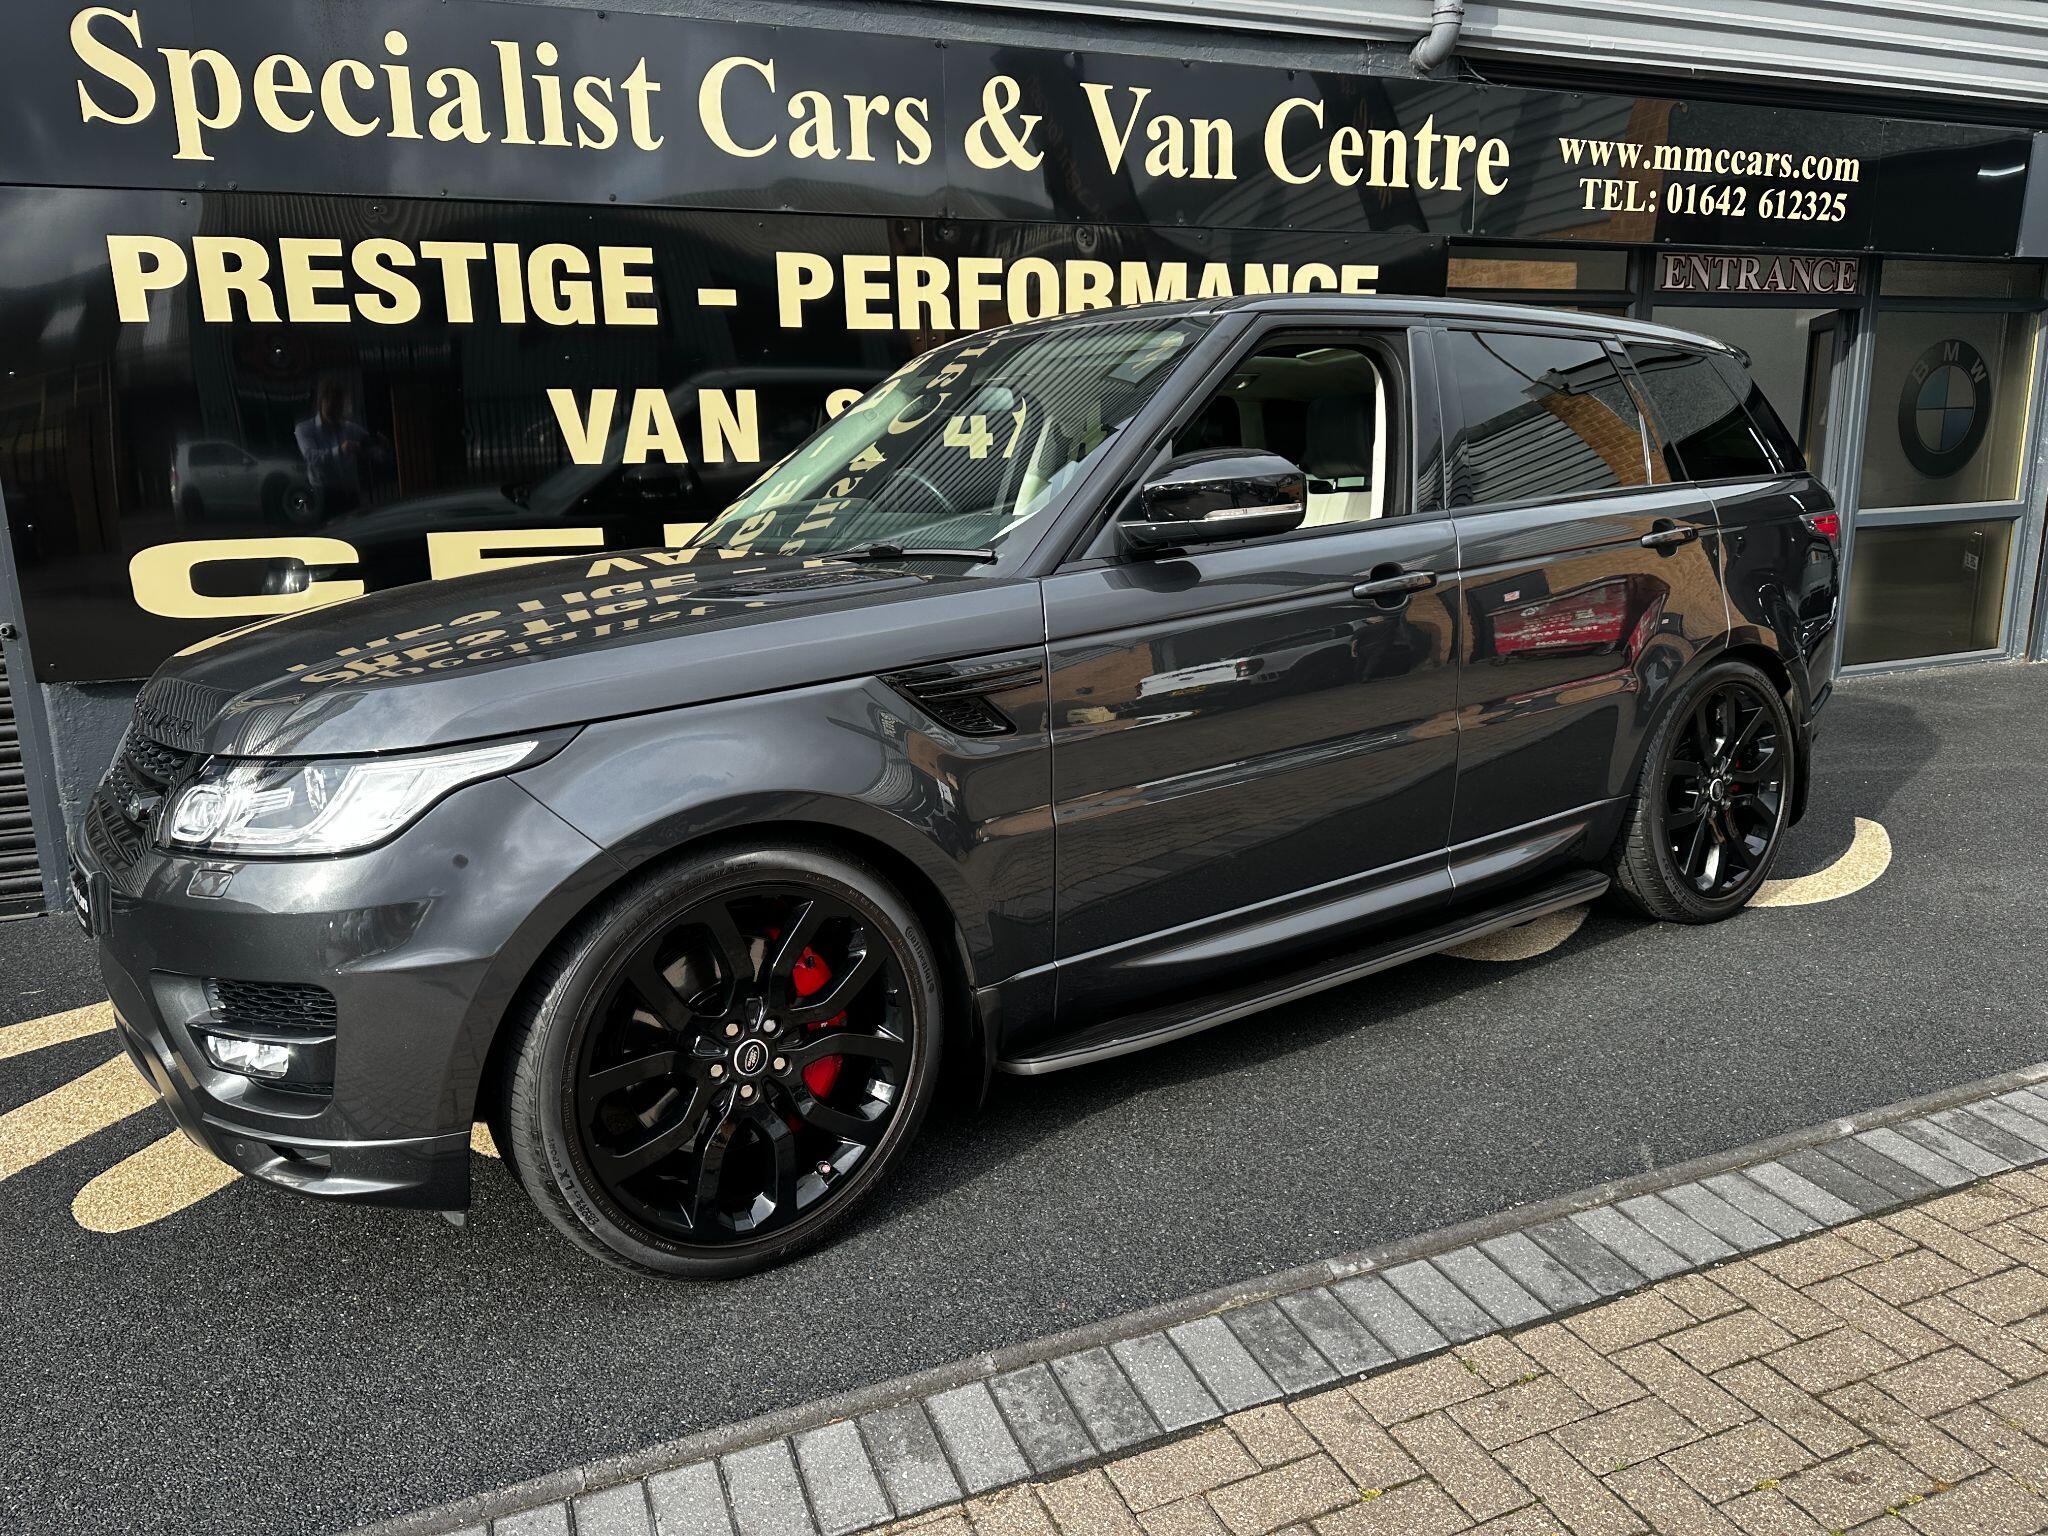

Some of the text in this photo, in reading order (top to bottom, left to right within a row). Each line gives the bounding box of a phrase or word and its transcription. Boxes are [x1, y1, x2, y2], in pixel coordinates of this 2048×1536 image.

[70, 8, 664, 161] Specialist
[697, 57, 934, 166] Cars
[964, 75, 1044, 172] &
[1079, 82, 1238, 180] Van
[1263, 98, 1511, 196] Centre
[1558, 137, 1860, 183] www.mmccars.com
[1579, 177, 1848, 223] TEL: 01642 612325
[107, 235, 660, 326] PRESTIGE
[1661, 254, 1857, 295] ENTRANCE
[1911, 341, 1986, 386] BMW
[547, 388, 761, 465] VAN
